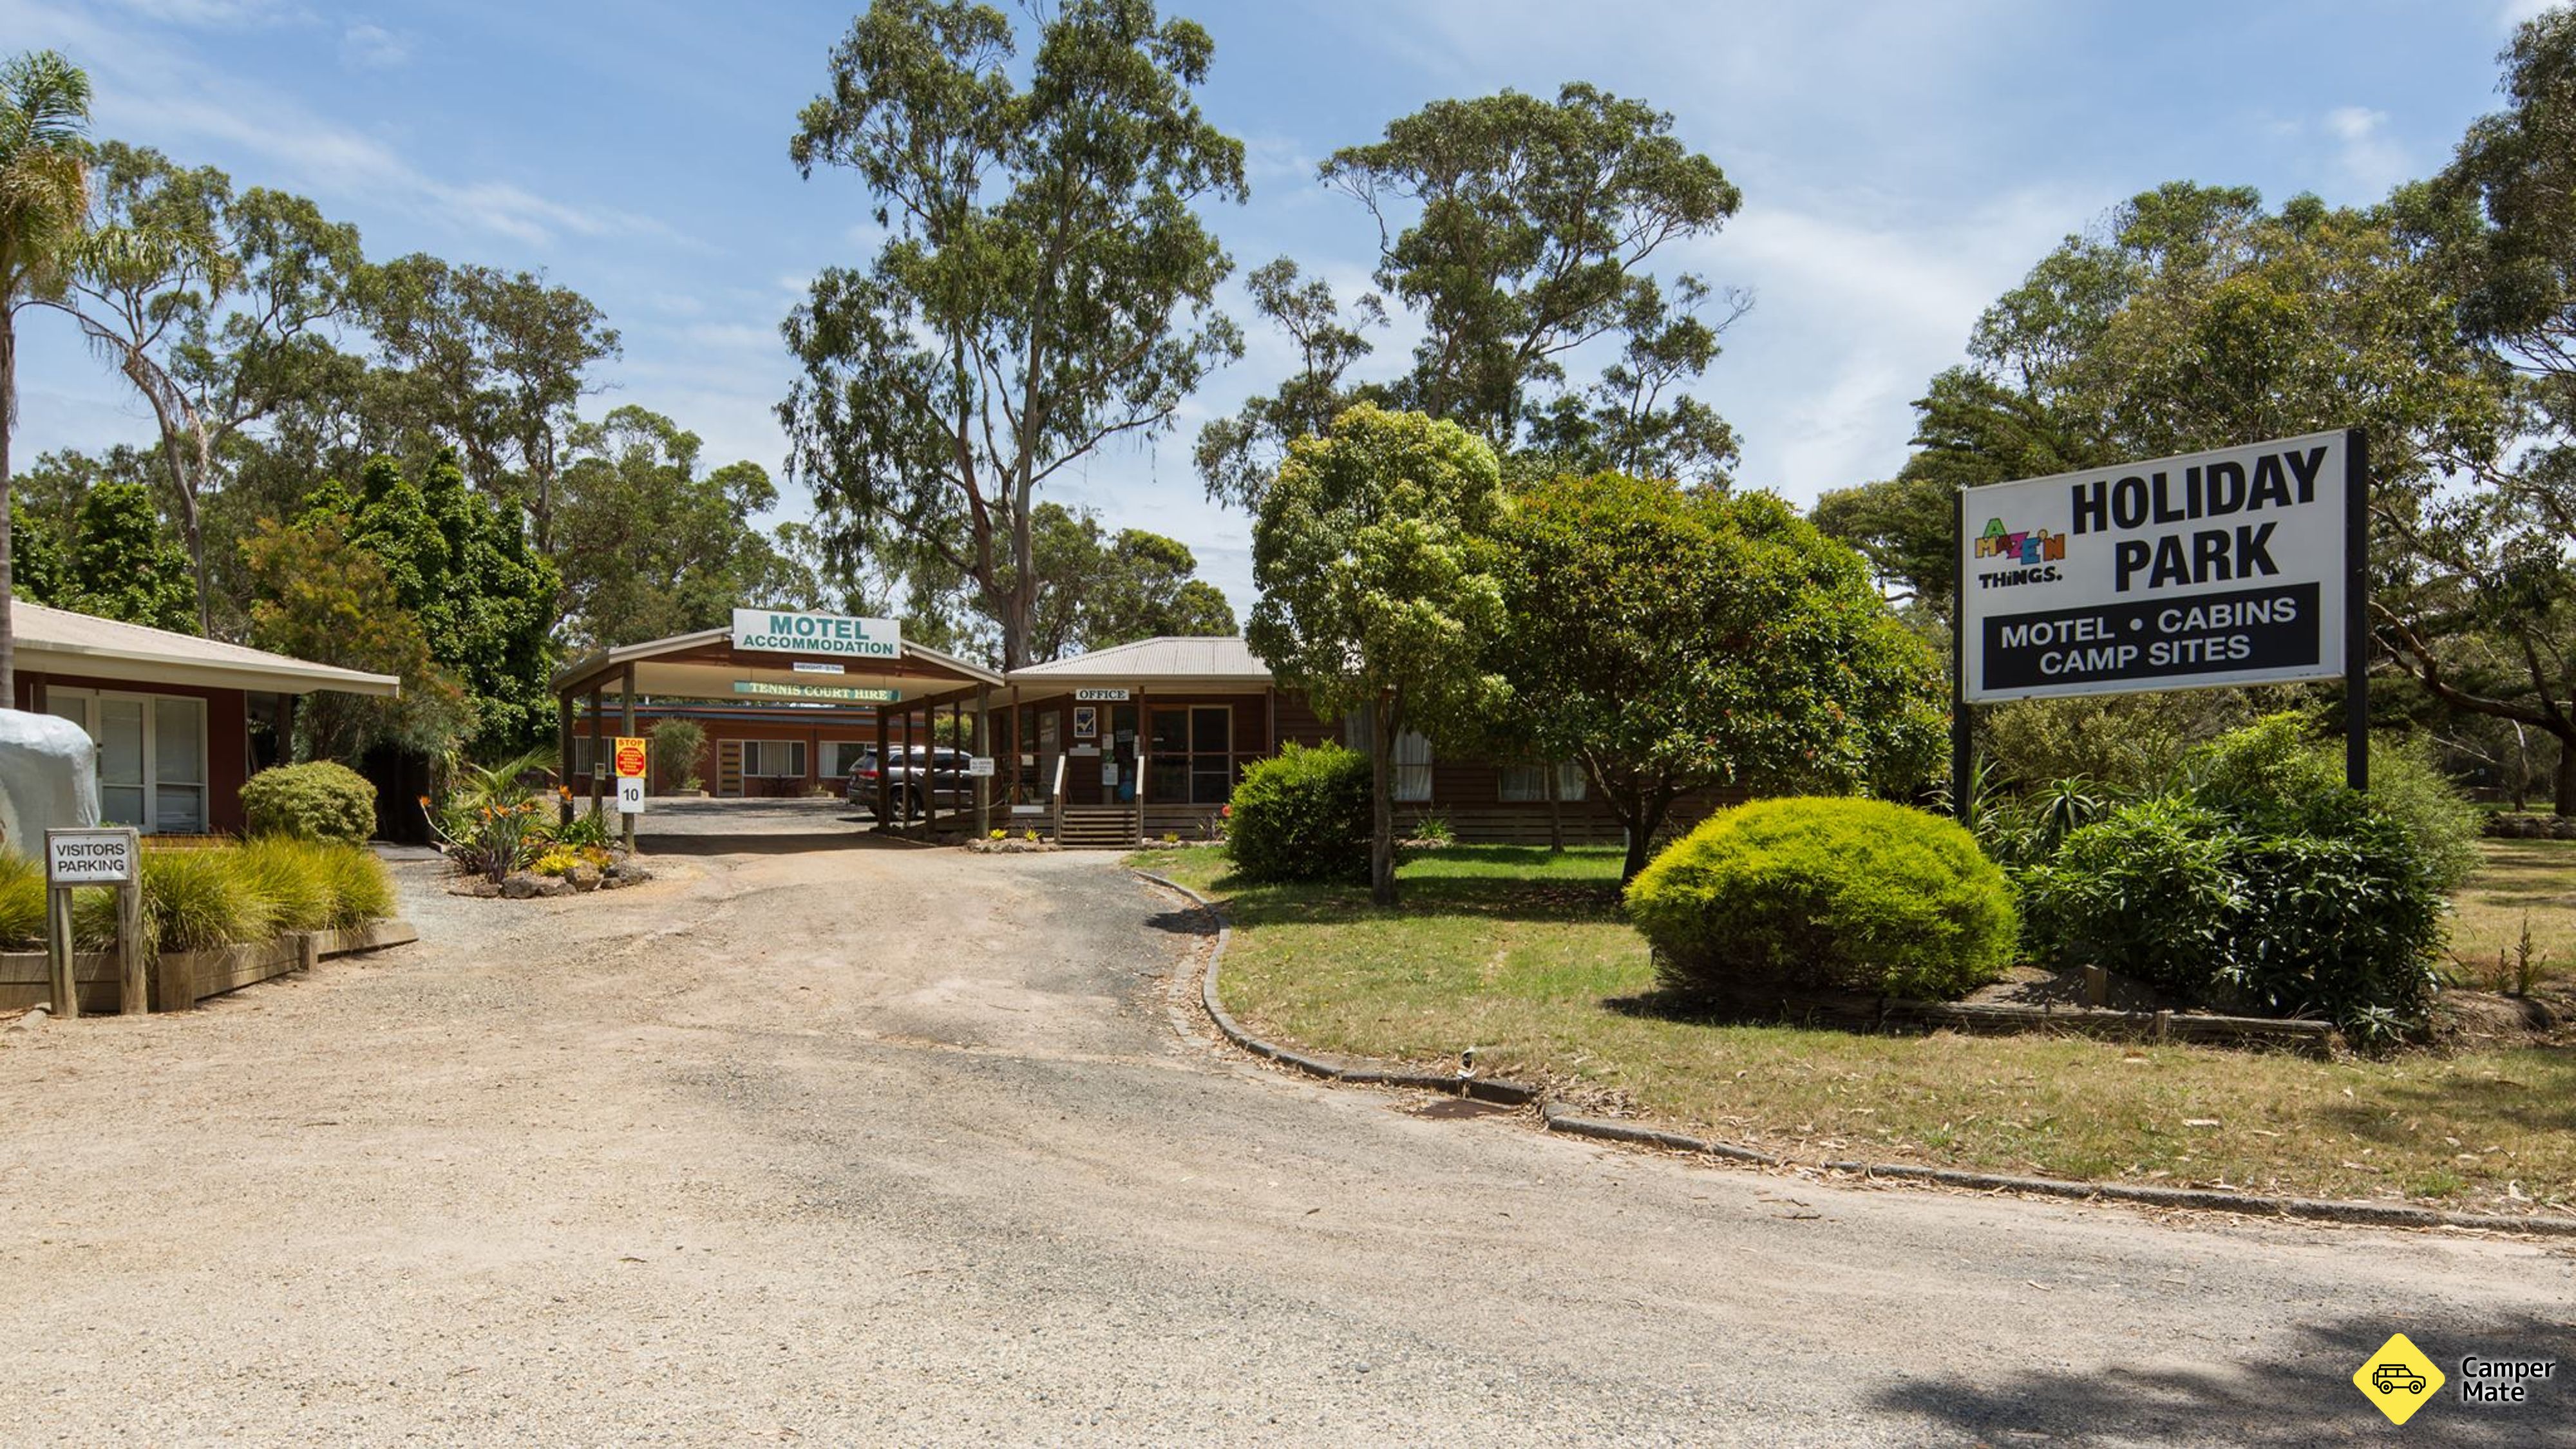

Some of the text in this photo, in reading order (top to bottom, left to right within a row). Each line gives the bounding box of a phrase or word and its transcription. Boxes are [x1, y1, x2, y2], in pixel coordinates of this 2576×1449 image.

[2072, 446, 2328, 535] HOLIDAY
[2116, 522, 2280, 592] PARK
[770, 615, 870, 640] MOTEL
[2001, 597, 2297, 649] MOTEL CABINS
[743, 634, 893, 655] ACCOMMODATION
[2040, 634, 2251, 676] CAMP SITES
[750, 683, 888, 701] TENNIS COURT HIRE
[1079, 690, 1126, 699] OFFICE
[623, 788, 639, 801] 10
[56, 844, 125, 857] VISITORS
[58, 859, 124, 872] PARKING
